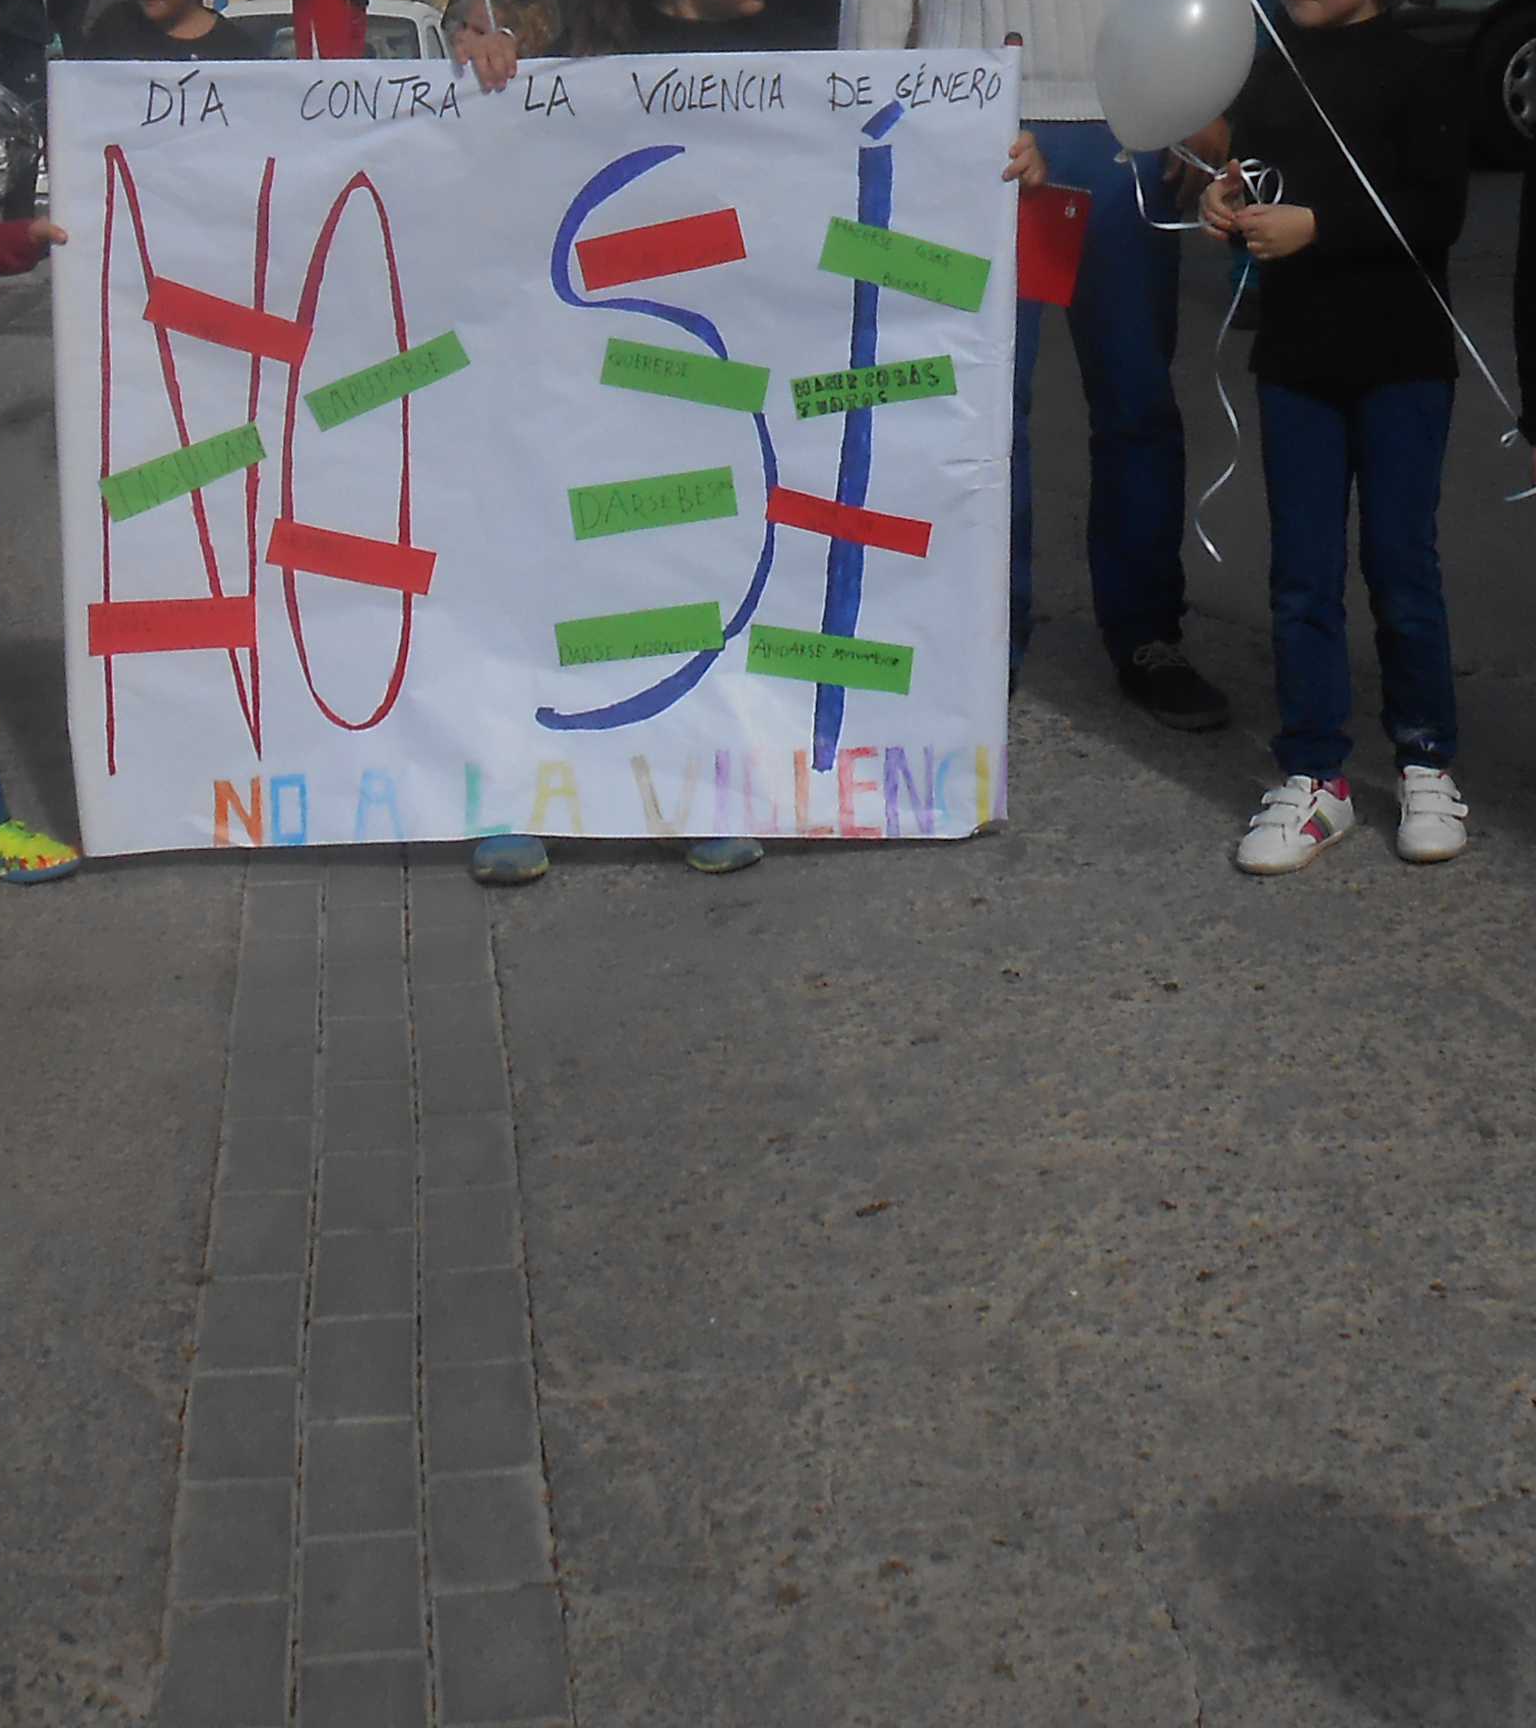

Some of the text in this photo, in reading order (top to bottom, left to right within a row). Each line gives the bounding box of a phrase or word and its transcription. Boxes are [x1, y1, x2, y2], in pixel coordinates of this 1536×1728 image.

[141, 64, 1002, 127] DÍA CONTRA LA VIOLENCIA DE GÉNERO
[100, 144, 413, 776] NO
[213, 773, 308, 848] NO
[354, 768, 405, 841] A
[464, 760, 583, 835] LA
